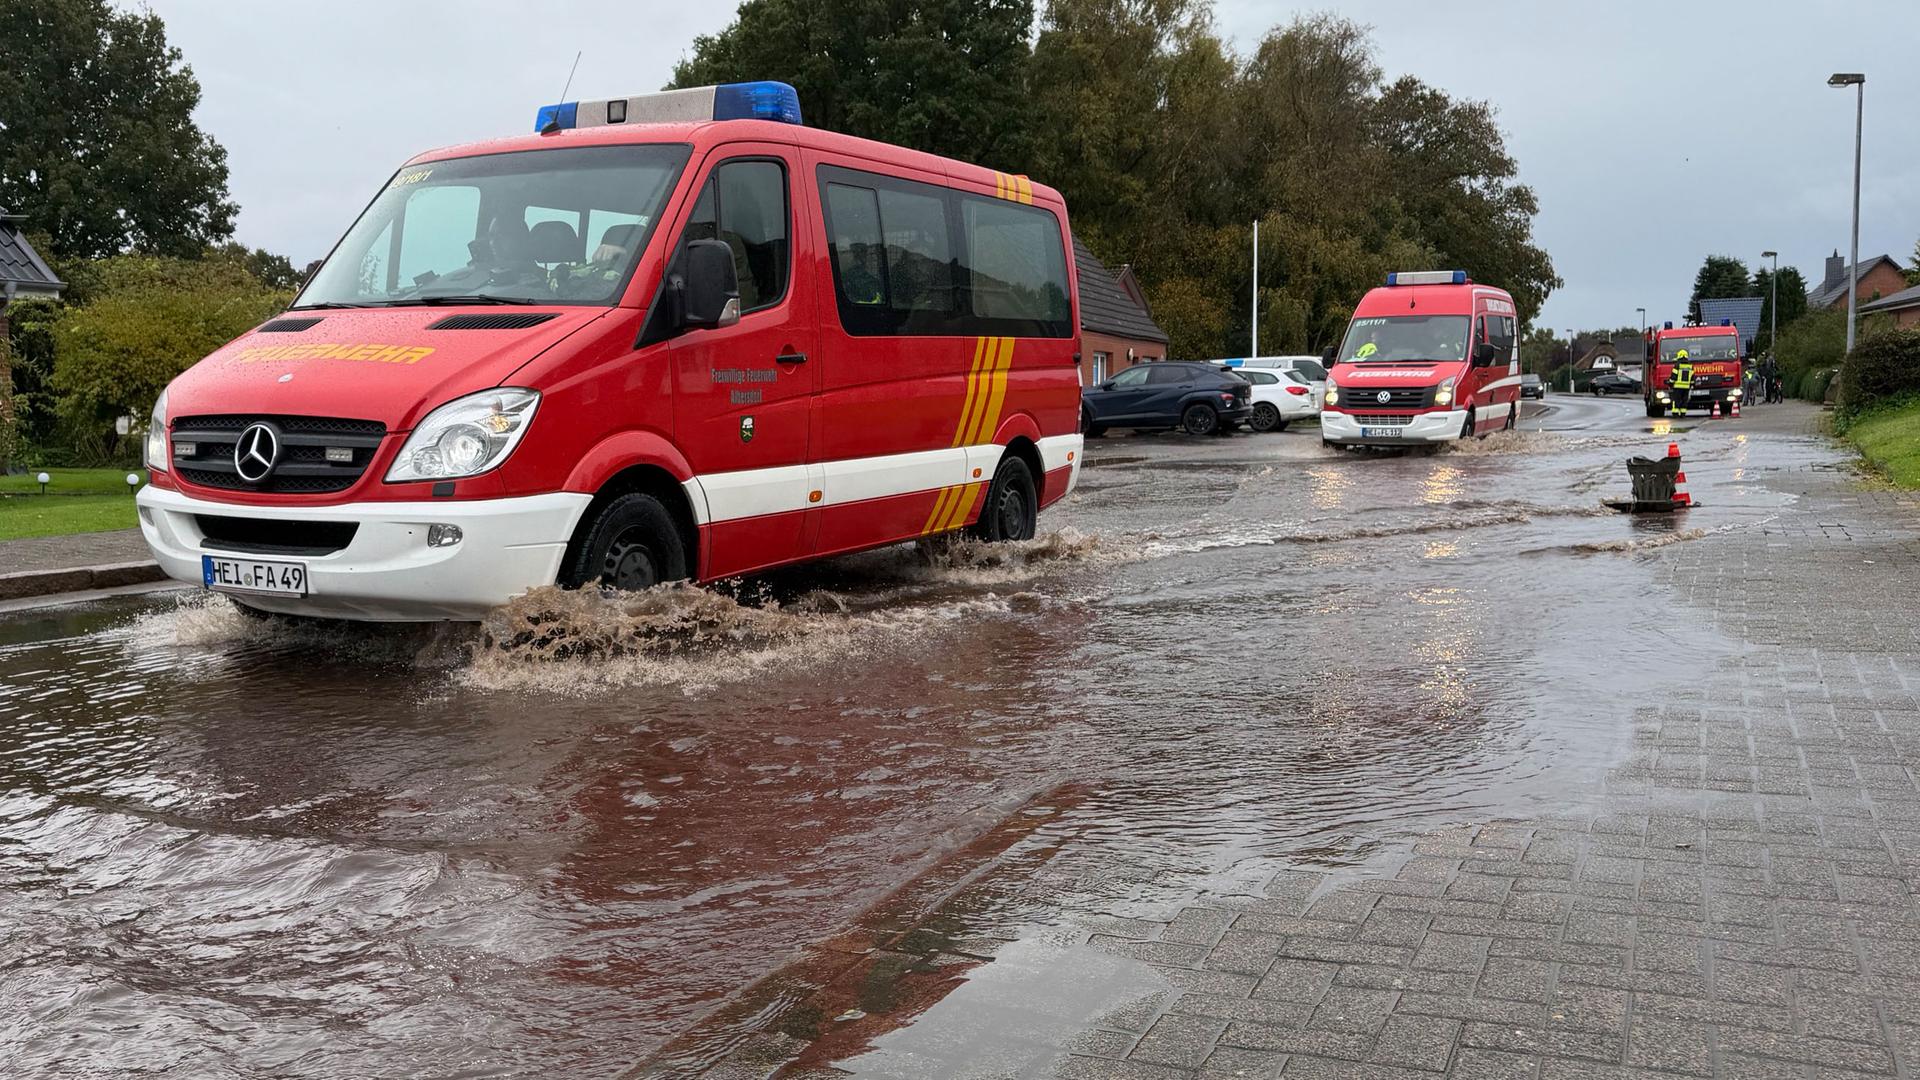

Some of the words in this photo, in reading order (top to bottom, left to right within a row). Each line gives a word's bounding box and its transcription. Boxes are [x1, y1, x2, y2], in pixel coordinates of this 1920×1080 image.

[1693, 365, 1724, 373] RWEHR
[212, 561, 242, 585] HEI
[253, 565, 276, 588] FA
[281, 567, 303, 589] 49
